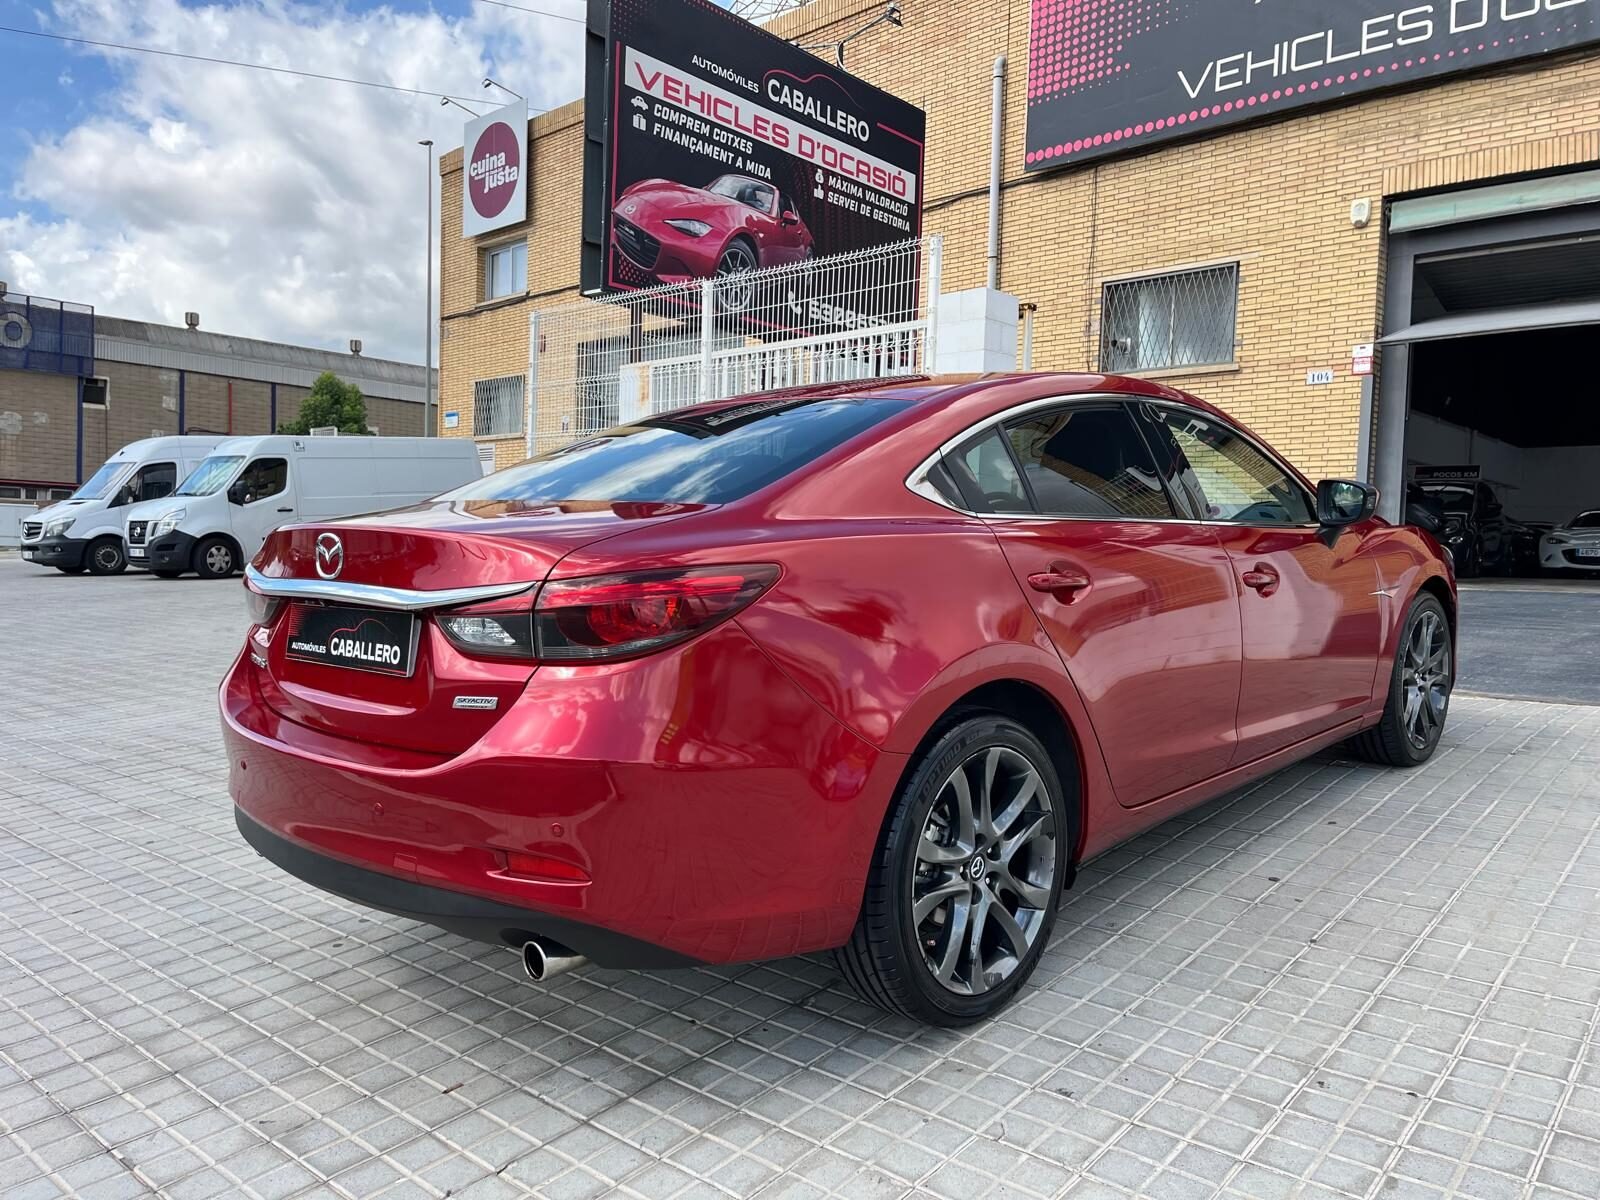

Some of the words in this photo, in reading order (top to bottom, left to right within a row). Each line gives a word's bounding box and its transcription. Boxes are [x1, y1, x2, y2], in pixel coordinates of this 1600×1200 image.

[1177, 5, 1433, 98] VEHICLES
[692, 54, 760, 93] AUTOMÓVILES
[767, 78, 869, 142] CABALLERO
[634, 61, 790, 148] VEHICLES
[798, 133, 906, 198] D'OCASIÓ
[653, 103, 711, 137] COMPREM
[713, 127, 753, 155] COTXES
[470, 151, 506, 177] cuina
[653, 122, 734, 165] FINANÇAMENT
[735, 156, 743, 169] A
[745, 159, 771, 180] MIDA
[483, 165, 518, 194] justa
[828, 175, 863, 199] MÀXIMA
[865, 189, 908, 216] VALORACIÓ
[827, 191, 858, 212] SERVEI
[860, 203, 872, 217] DE
[873, 208, 910, 232] GESTORIA
[1311, 372, 1330, 383] 104
[291, 641, 326, 654] AUTOMÓVILES
[330, 637, 400, 665] CABALLERO
